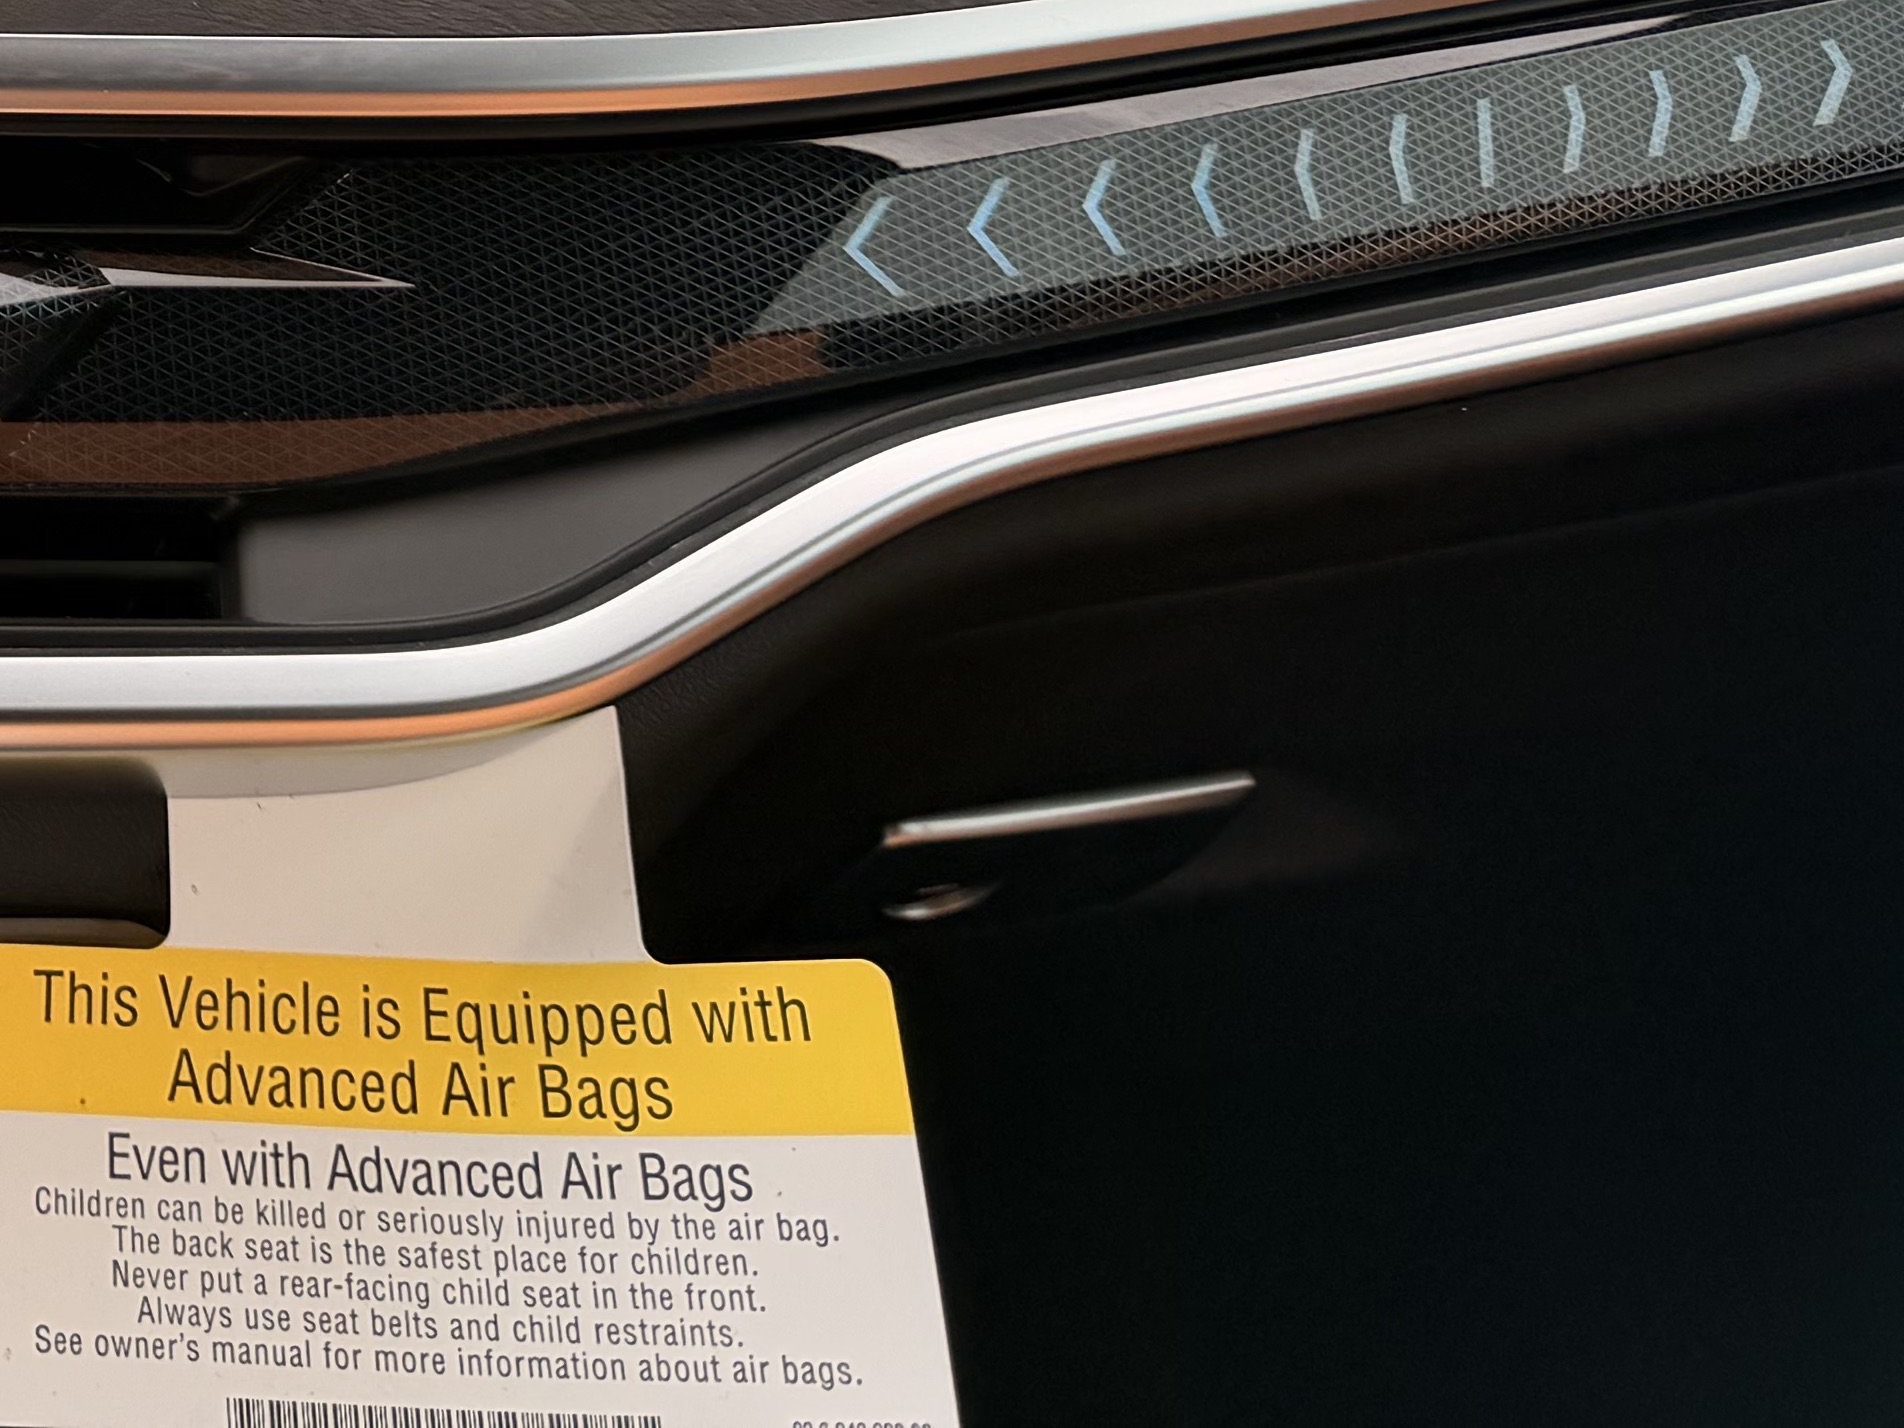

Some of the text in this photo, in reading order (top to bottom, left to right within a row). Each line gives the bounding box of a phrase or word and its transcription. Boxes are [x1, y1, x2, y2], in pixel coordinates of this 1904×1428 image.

[34, 970, 811, 1057] This Vehicle is Equipped with
[168, 1048, 672, 1132] Advanced Air Bags
[109, 1132, 752, 1212] Even with Advanced Air Bags
[36, 1187, 838, 1247] Children can be killed or seriously injured by the air bag.
[112, 1225, 757, 1277] The back seat is the safest place for children.
[113, 1260, 765, 1311] Never put a rear-facing child seat in the front.
[138, 1296, 743, 1347] Always use seat belts and child restraints.
[36, 1325, 862, 1391] See owner's manual for more information about air bags.
